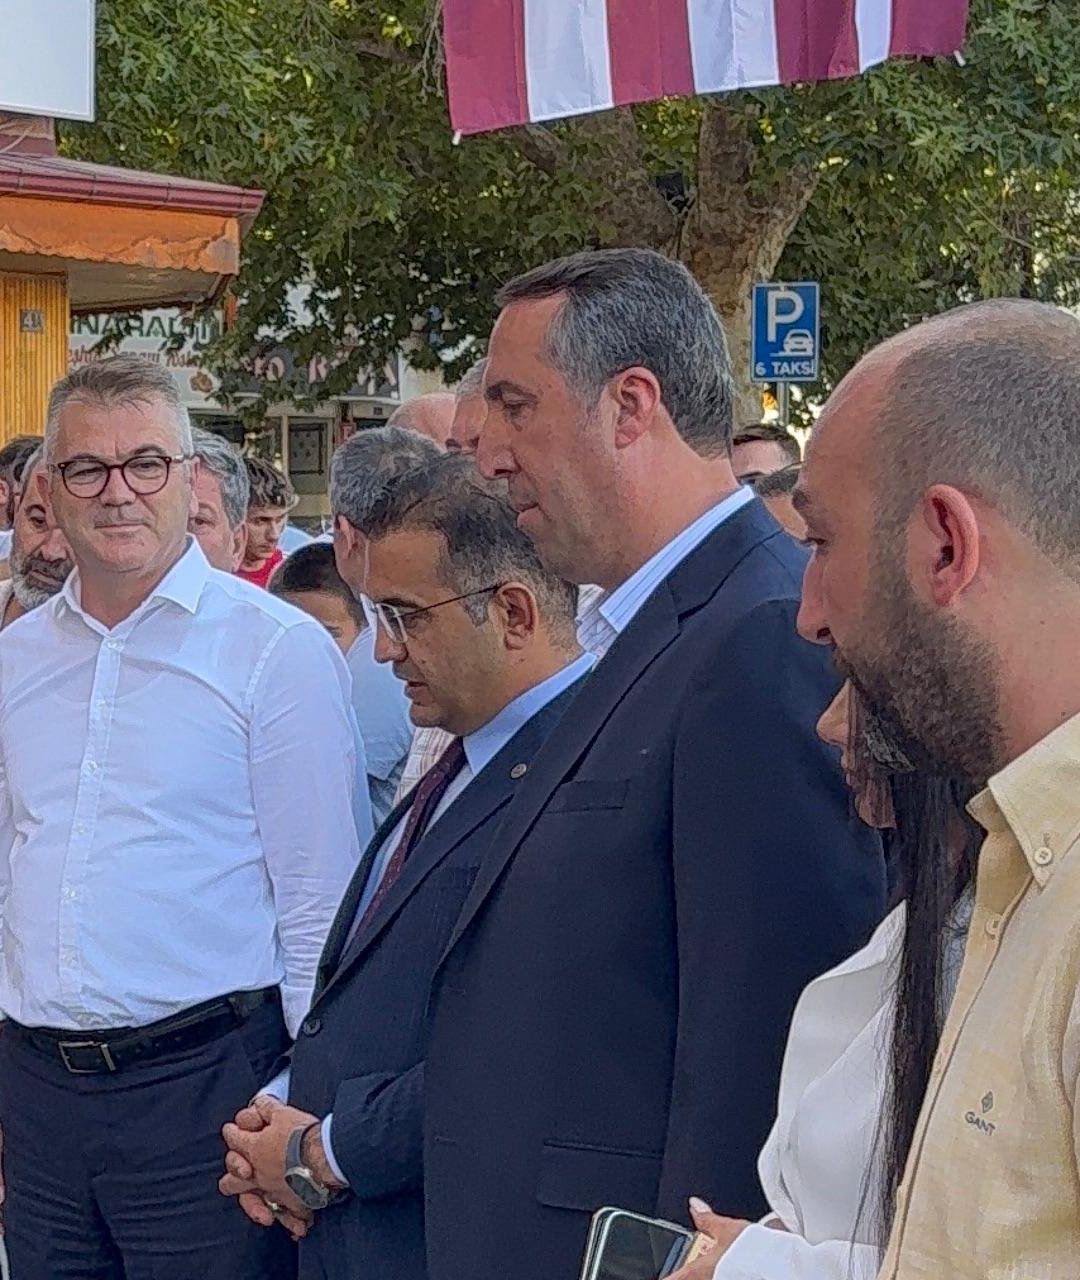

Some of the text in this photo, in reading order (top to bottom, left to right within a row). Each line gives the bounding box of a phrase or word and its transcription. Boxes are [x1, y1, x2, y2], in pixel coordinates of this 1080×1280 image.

[767, 290, 805, 343] P
[755, 361, 767, 377] 6
[964, 1111, 996, 1136] GANT
